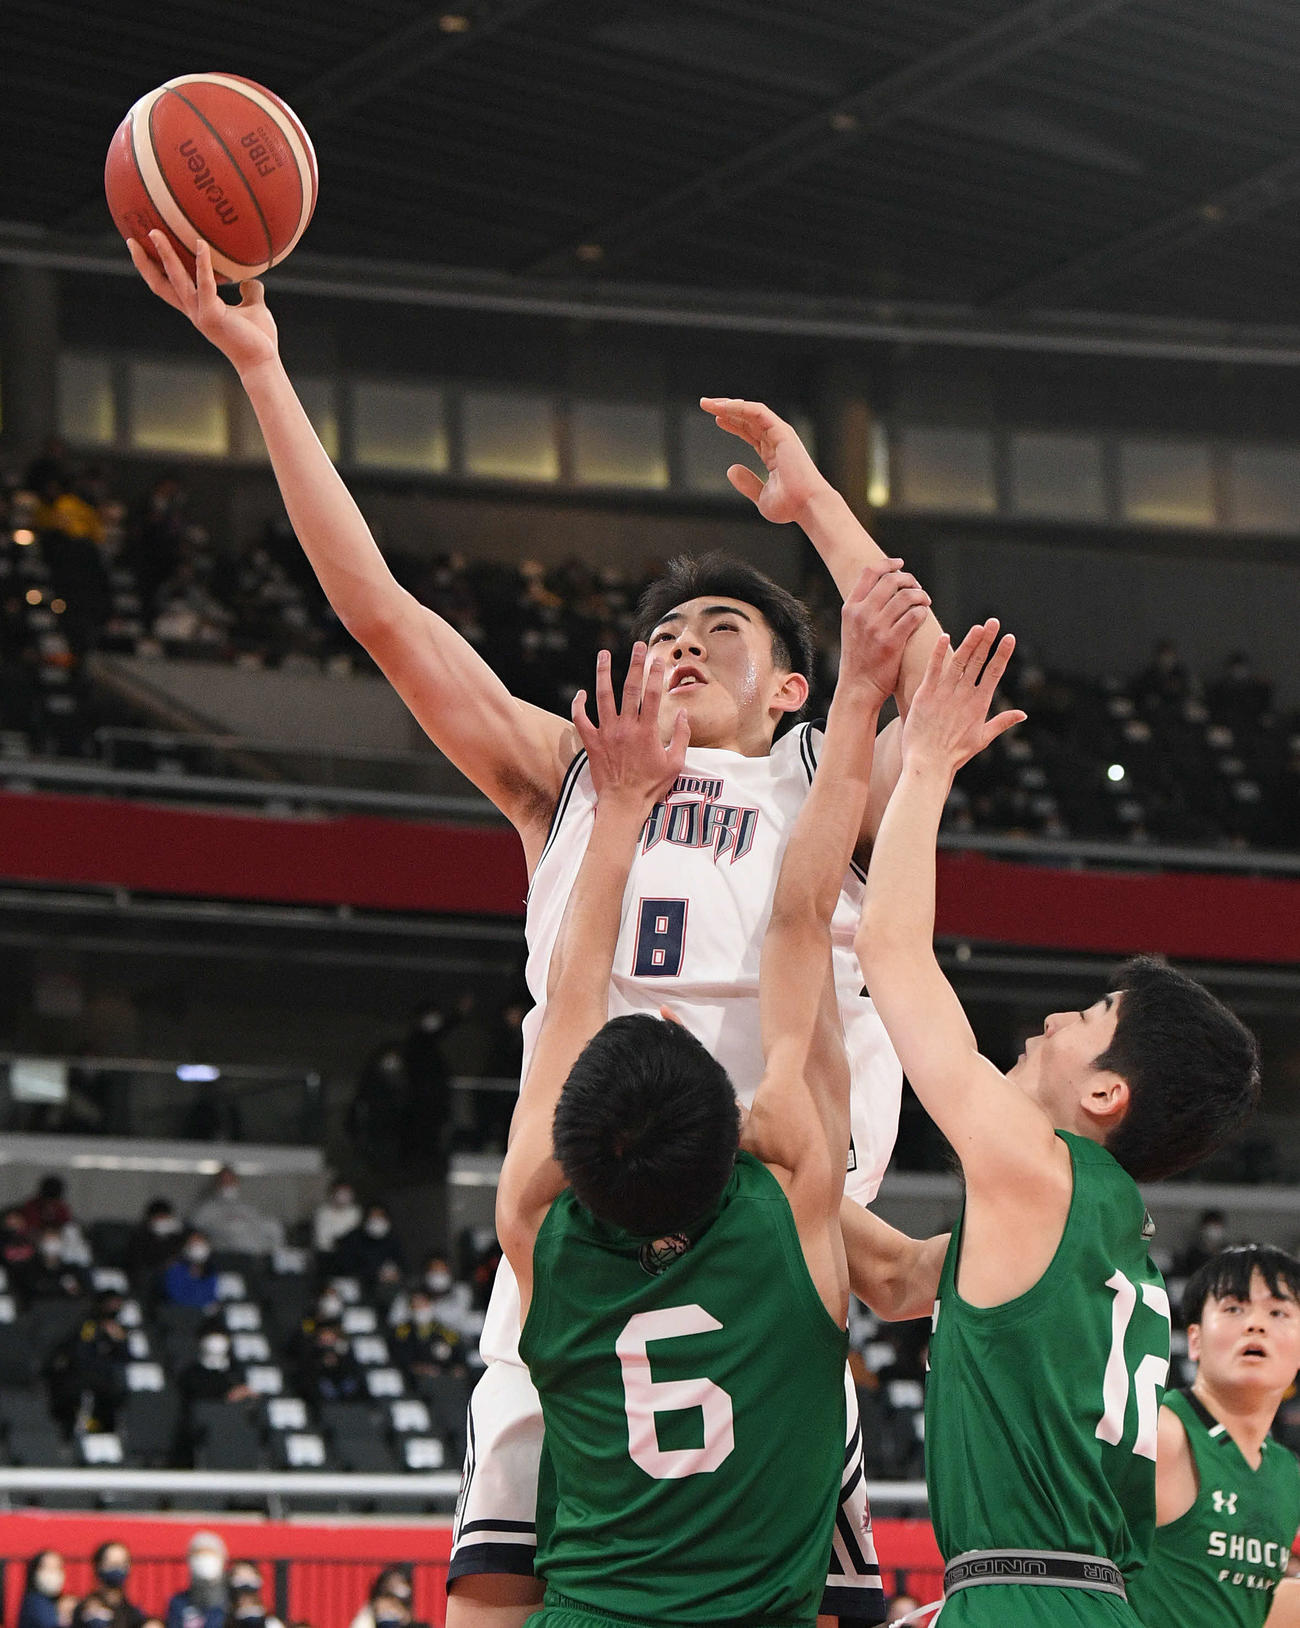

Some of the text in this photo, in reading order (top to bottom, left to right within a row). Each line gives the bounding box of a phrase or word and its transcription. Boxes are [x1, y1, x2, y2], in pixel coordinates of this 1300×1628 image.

[179, 138, 240, 226] molten
[241, 131, 276, 178] FIBA
[637, 801, 760, 865] HORI
[630, 897, 689, 978] 8
[615, 1304, 735, 1480] 6
[1095, 1268, 1172, 1462] 12
